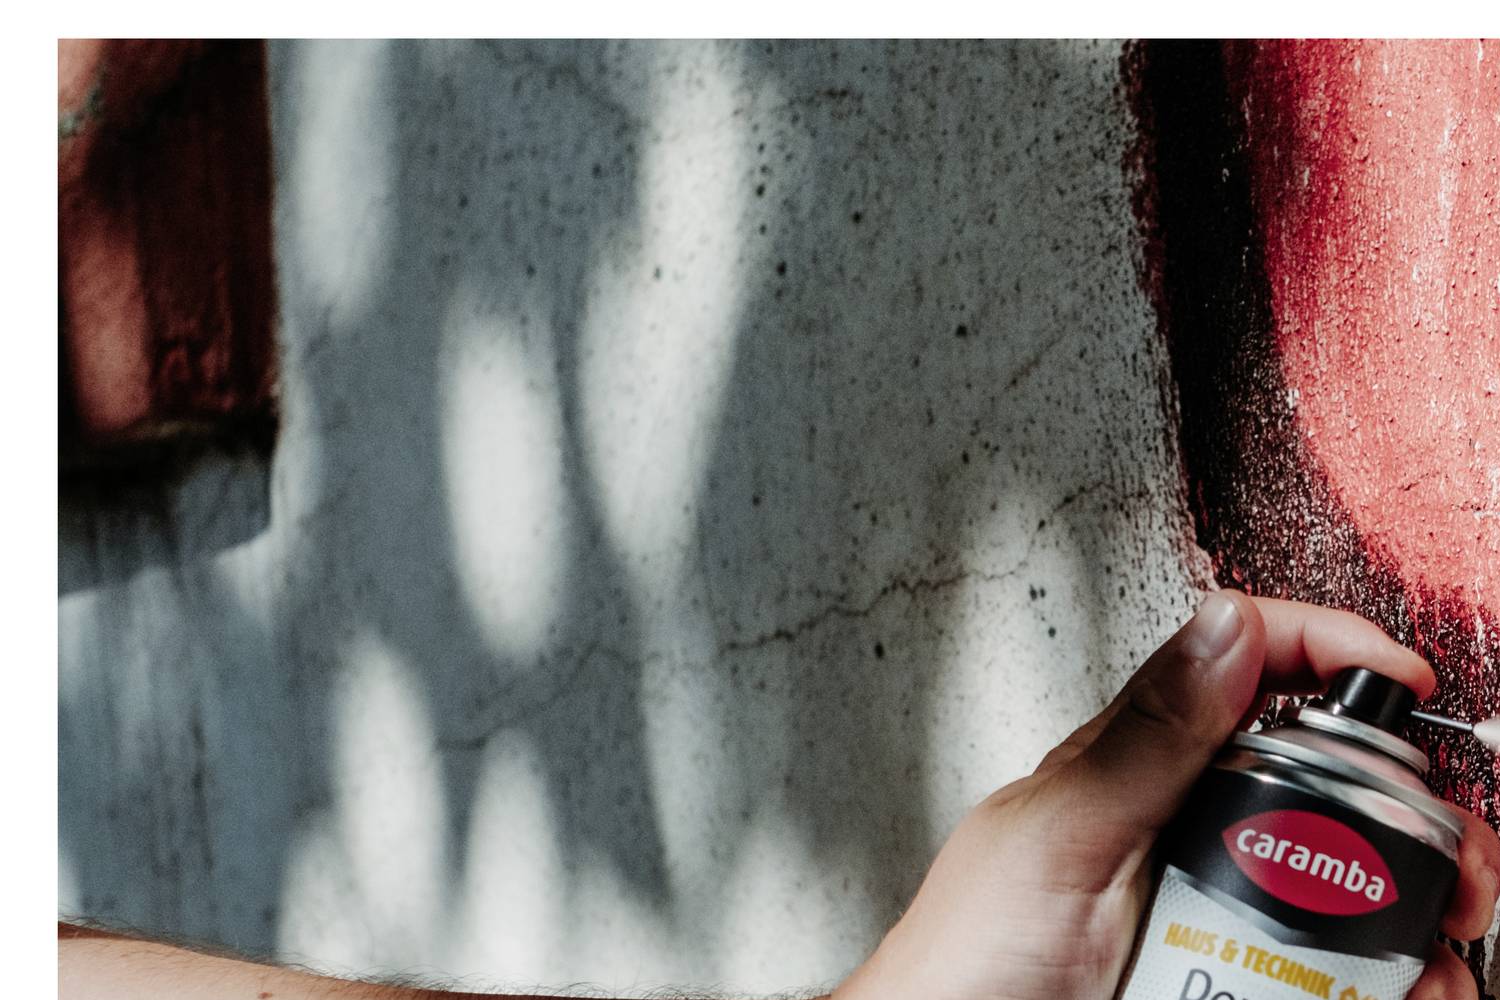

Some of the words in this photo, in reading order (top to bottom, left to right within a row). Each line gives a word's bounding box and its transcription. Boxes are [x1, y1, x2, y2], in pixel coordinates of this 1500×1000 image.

[1236, 827, 1387, 902] caramba
[1163, 921, 1220, 957] HAUS
[1219, 938, 1239, 964] &
[1241, 943, 1336, 1000] TECHNIK
